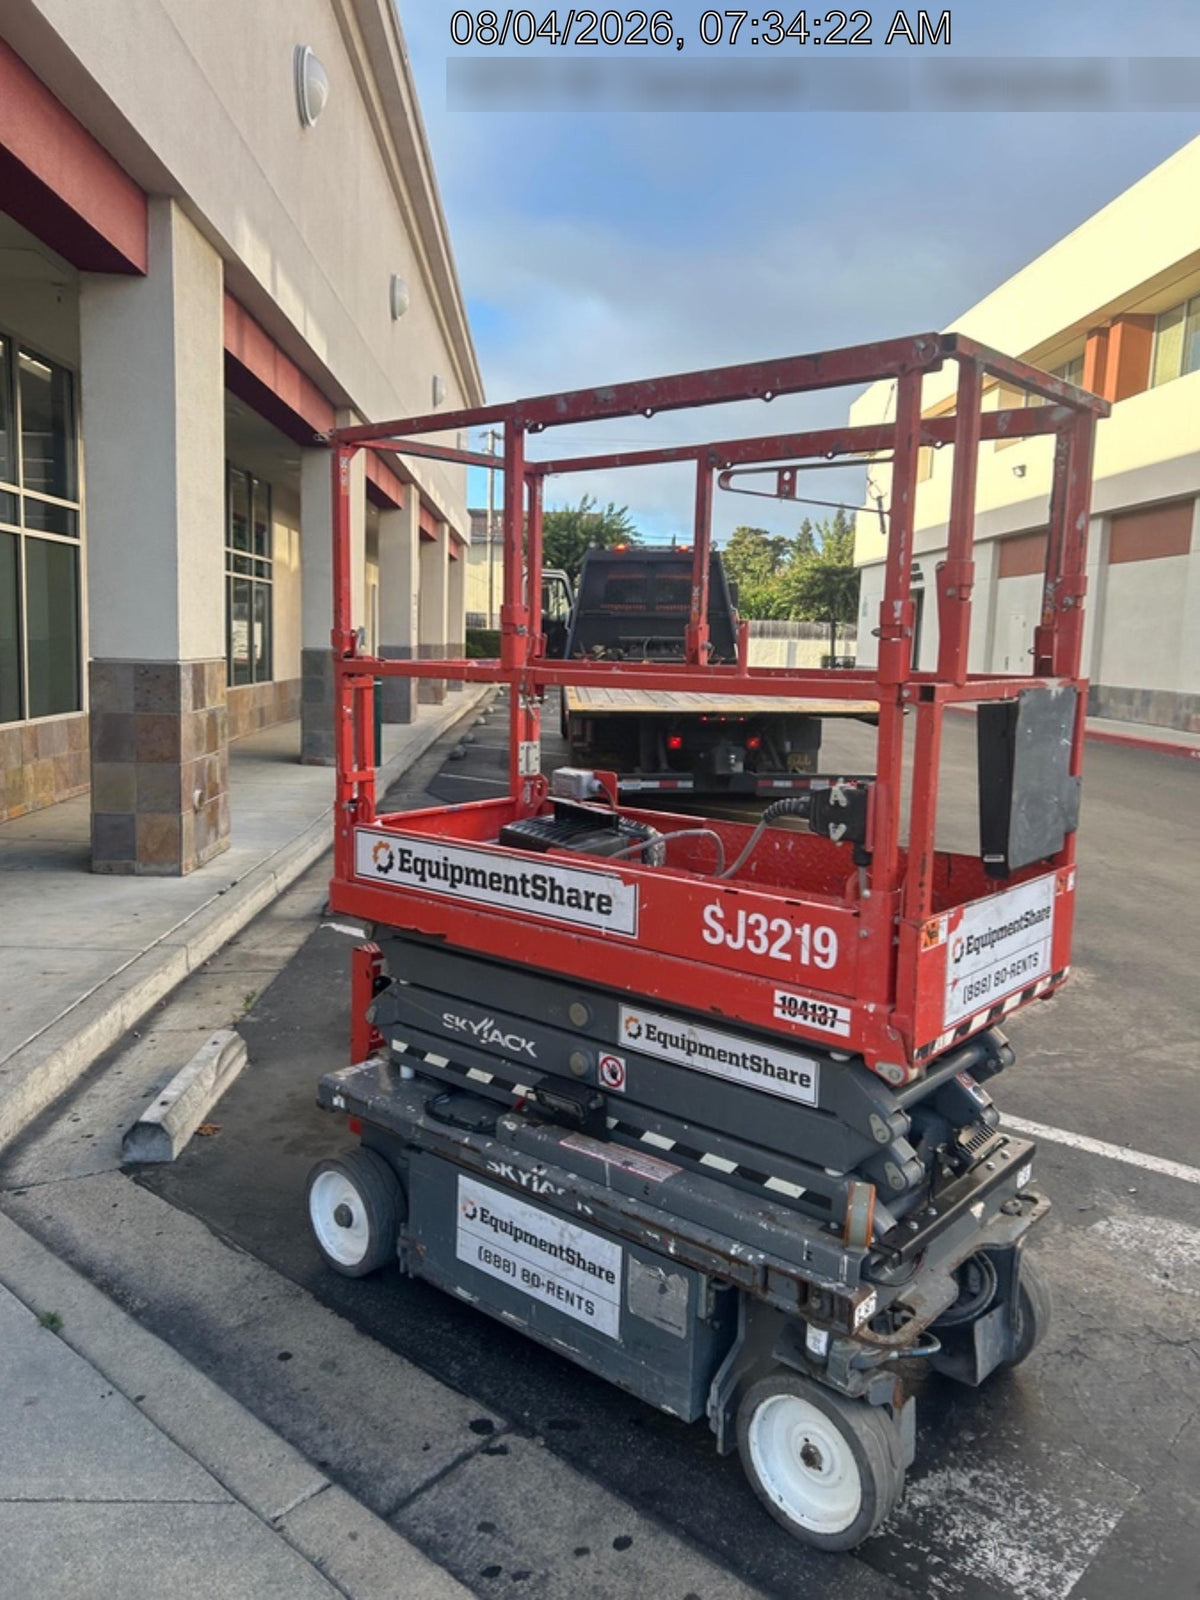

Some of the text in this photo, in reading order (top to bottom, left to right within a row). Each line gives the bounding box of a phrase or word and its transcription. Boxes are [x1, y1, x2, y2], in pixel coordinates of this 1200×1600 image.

[398, 848, 613, 916] EquipmentShare
[702, 904, 839, 970] SJ3219
[966, 906, 1051, 956] EquipmentShare
[963, 952, 1039, 1005] (888) 80-RENTS
[442, 1013, 537, 1058] SKYJACK
[645, 1024, 812, 1089] EquipmentShare
[479, 1207, 616, 1284] EquipmentShare
[477, 1245, 595, 1316] (888) 80-RENTS
